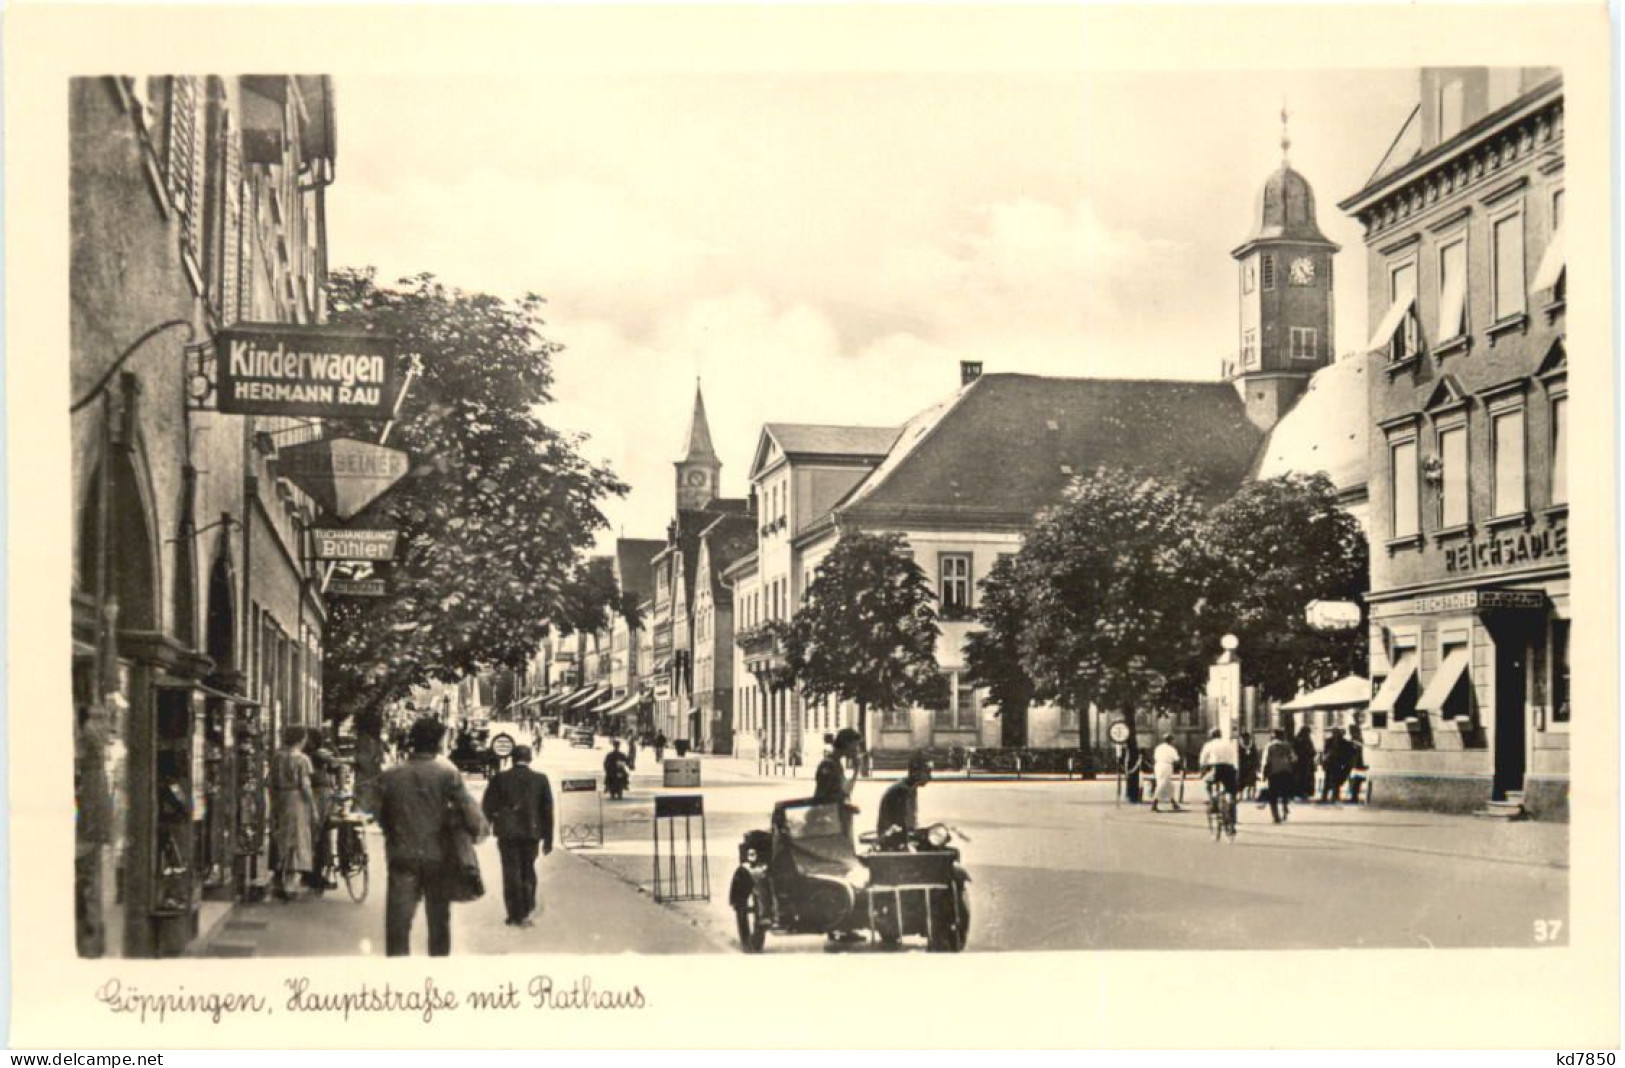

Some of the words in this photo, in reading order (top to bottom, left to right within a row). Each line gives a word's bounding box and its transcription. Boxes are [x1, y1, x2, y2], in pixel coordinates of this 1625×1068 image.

[229, 340, 385, 387] Kinderwagen
[234, 381, 333, 403] HERMANN
[338, 386, 380, 405] RAU
[323, 540, 389, 557] Bühler
